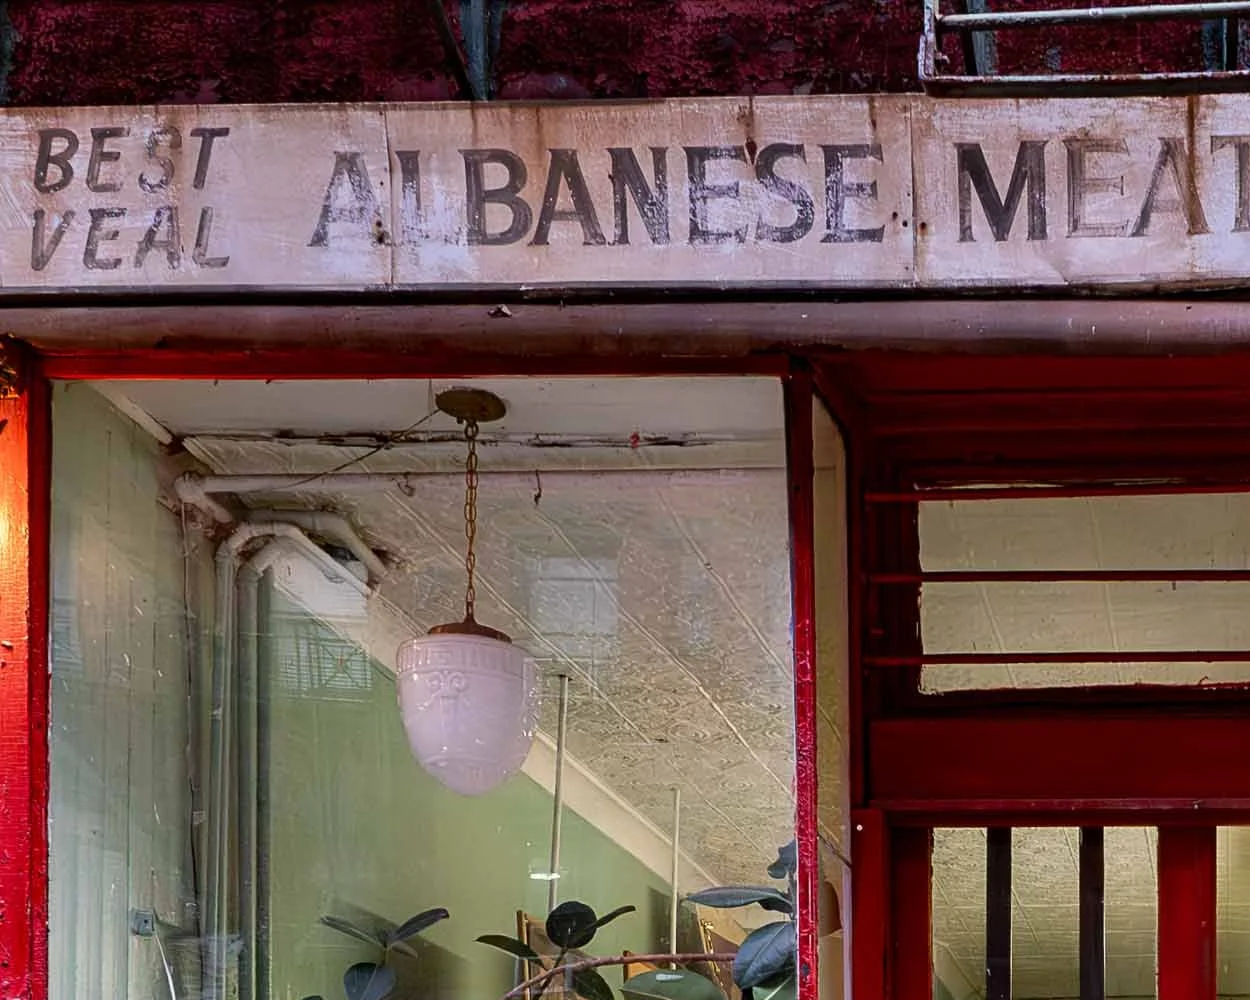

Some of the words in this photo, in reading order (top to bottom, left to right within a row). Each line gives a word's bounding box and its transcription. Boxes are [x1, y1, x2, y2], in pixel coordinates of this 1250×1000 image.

[34, 127, 230, 193] BEST
[306, 143, 885, 248] ALBANESE
[31, 205, 230, 271] VEAL
